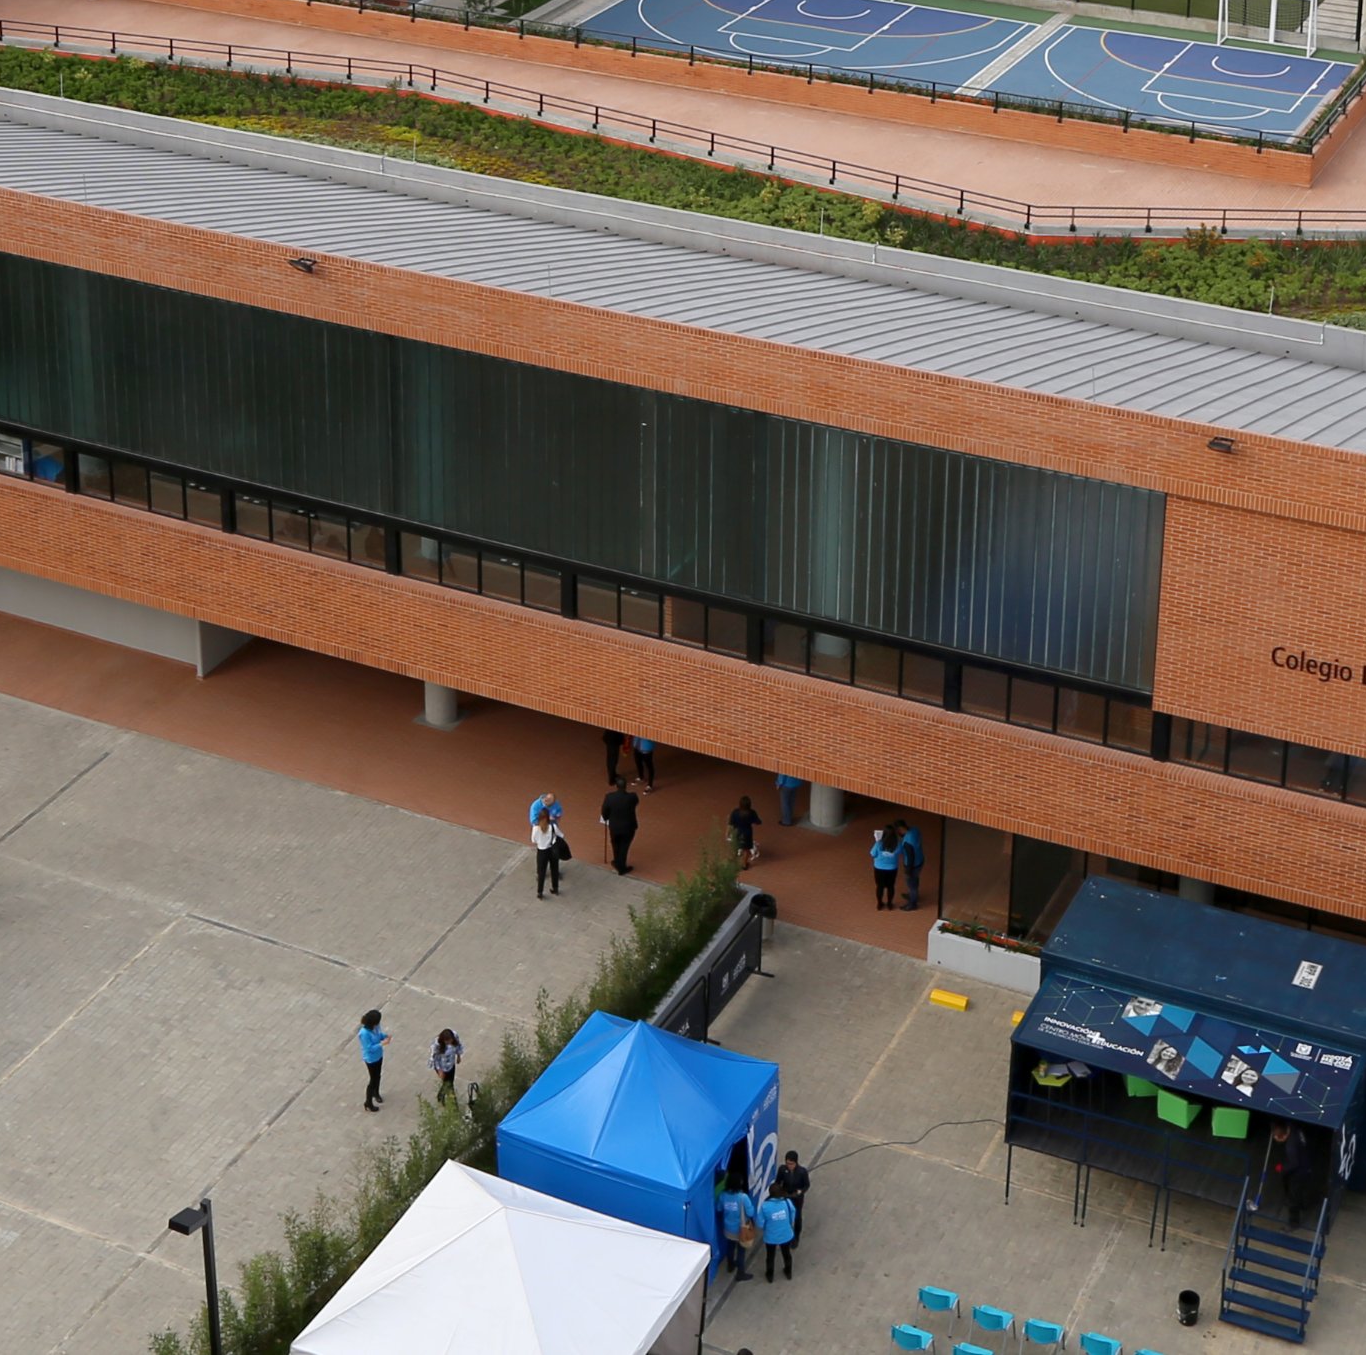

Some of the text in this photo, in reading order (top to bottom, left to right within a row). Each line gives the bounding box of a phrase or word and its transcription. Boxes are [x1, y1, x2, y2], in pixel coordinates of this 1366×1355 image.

[1271, 647, 1353, 683] Colegio
[1040, 1022, 1069, 1037] CENTRO
[1044, 1016, 1097, 1037] INNOVACIÓN
